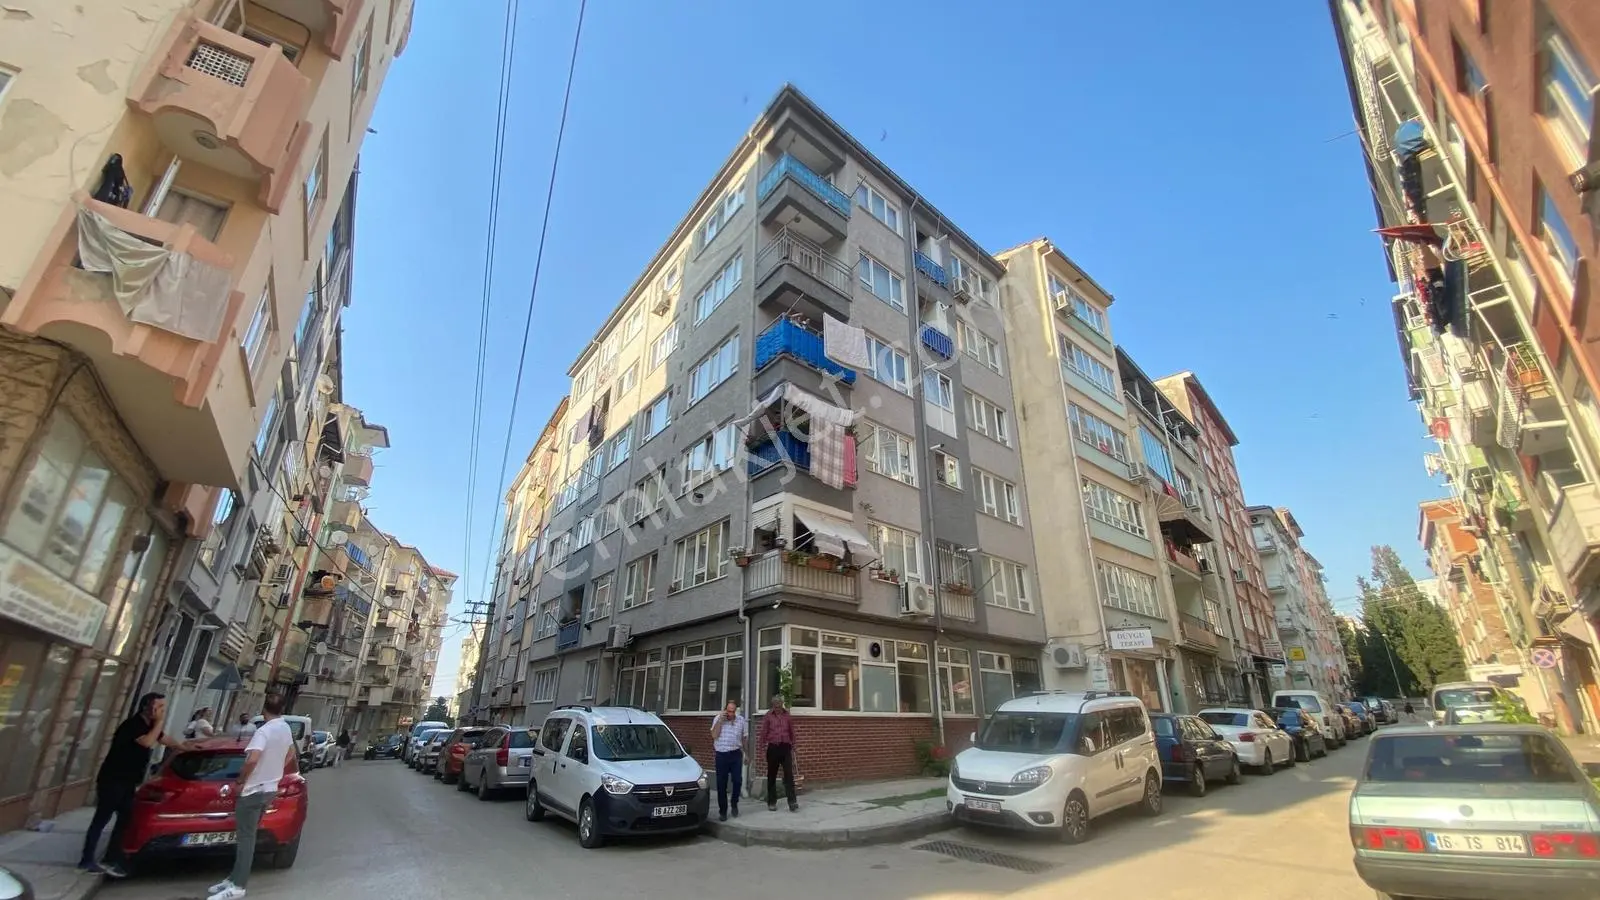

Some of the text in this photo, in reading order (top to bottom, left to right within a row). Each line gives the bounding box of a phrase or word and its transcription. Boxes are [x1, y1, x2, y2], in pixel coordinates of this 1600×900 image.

[655, 807, 662, 816] 16
[203, 832, 225, 843] NPS
[1436, 835, 1522, 850] 16 TS 814
